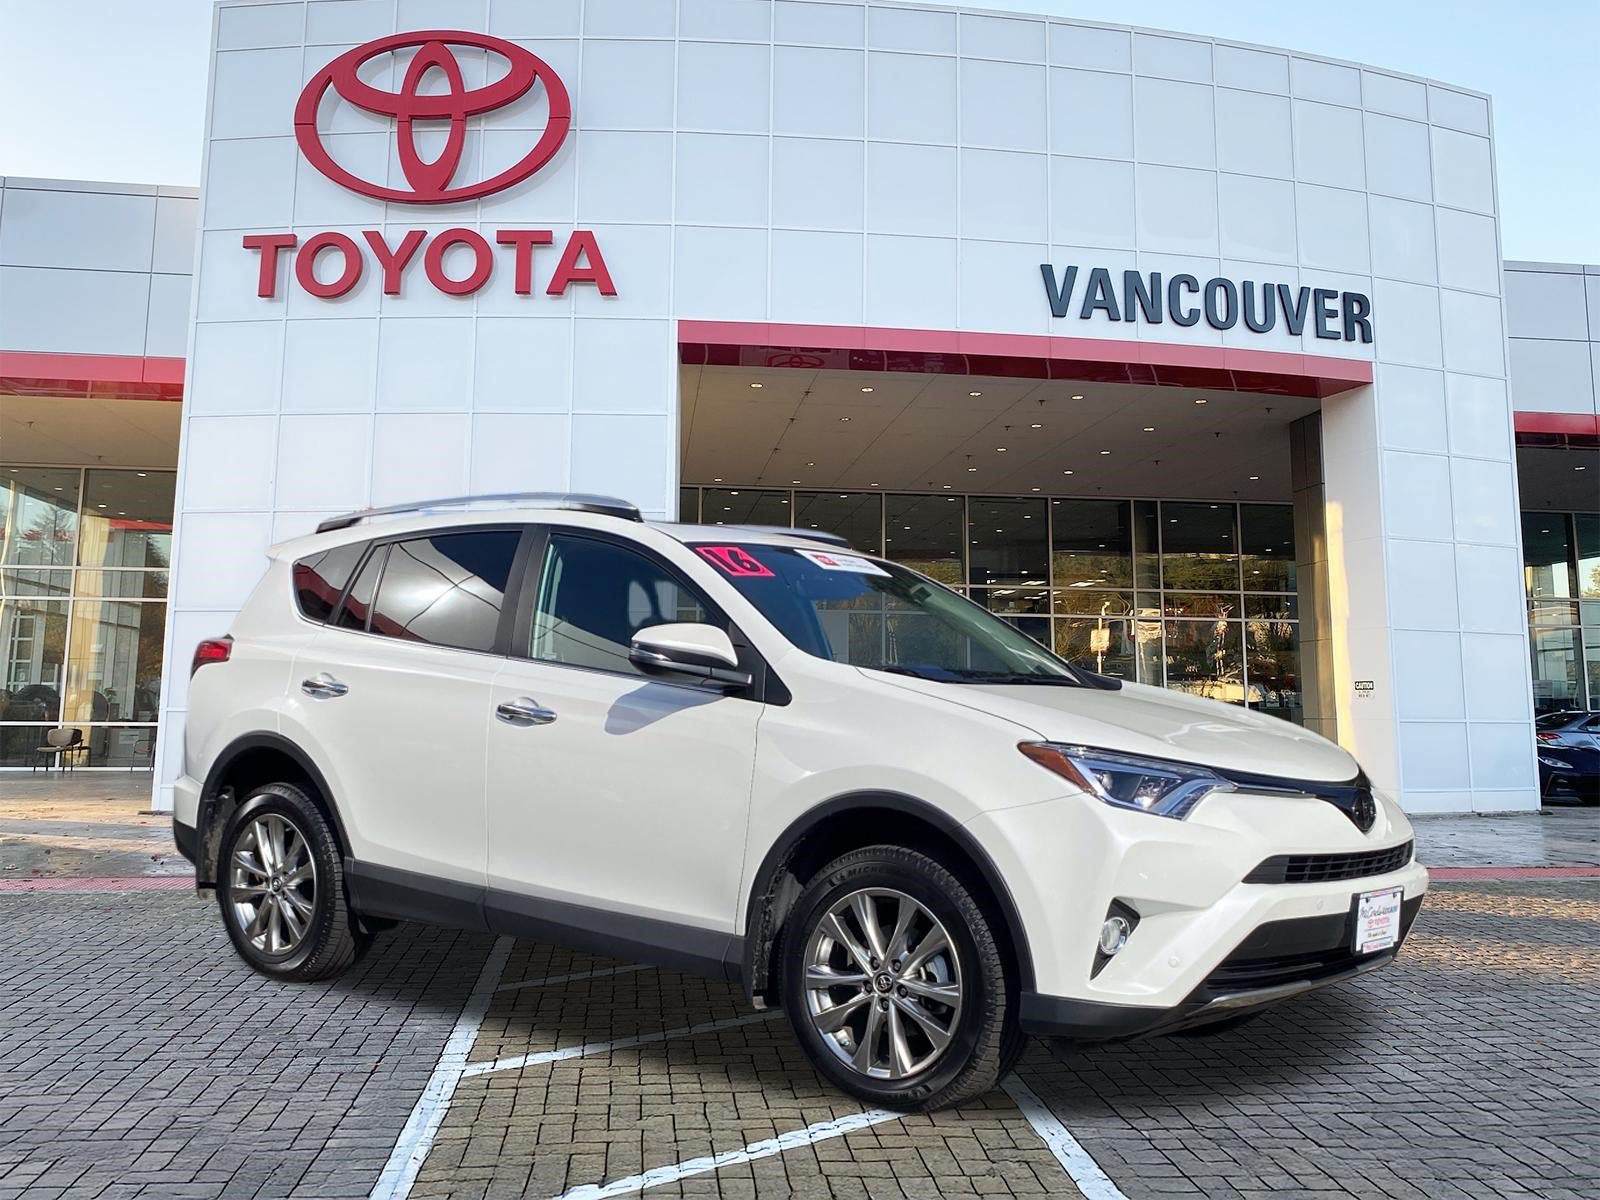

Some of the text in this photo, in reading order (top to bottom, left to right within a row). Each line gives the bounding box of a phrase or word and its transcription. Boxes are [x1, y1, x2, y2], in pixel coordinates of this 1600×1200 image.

[243, 228, 617, 298] TOYOTA
[1040, 264, 1373, 343] VANCOUVER
[702, 548, 761, 572] 16
